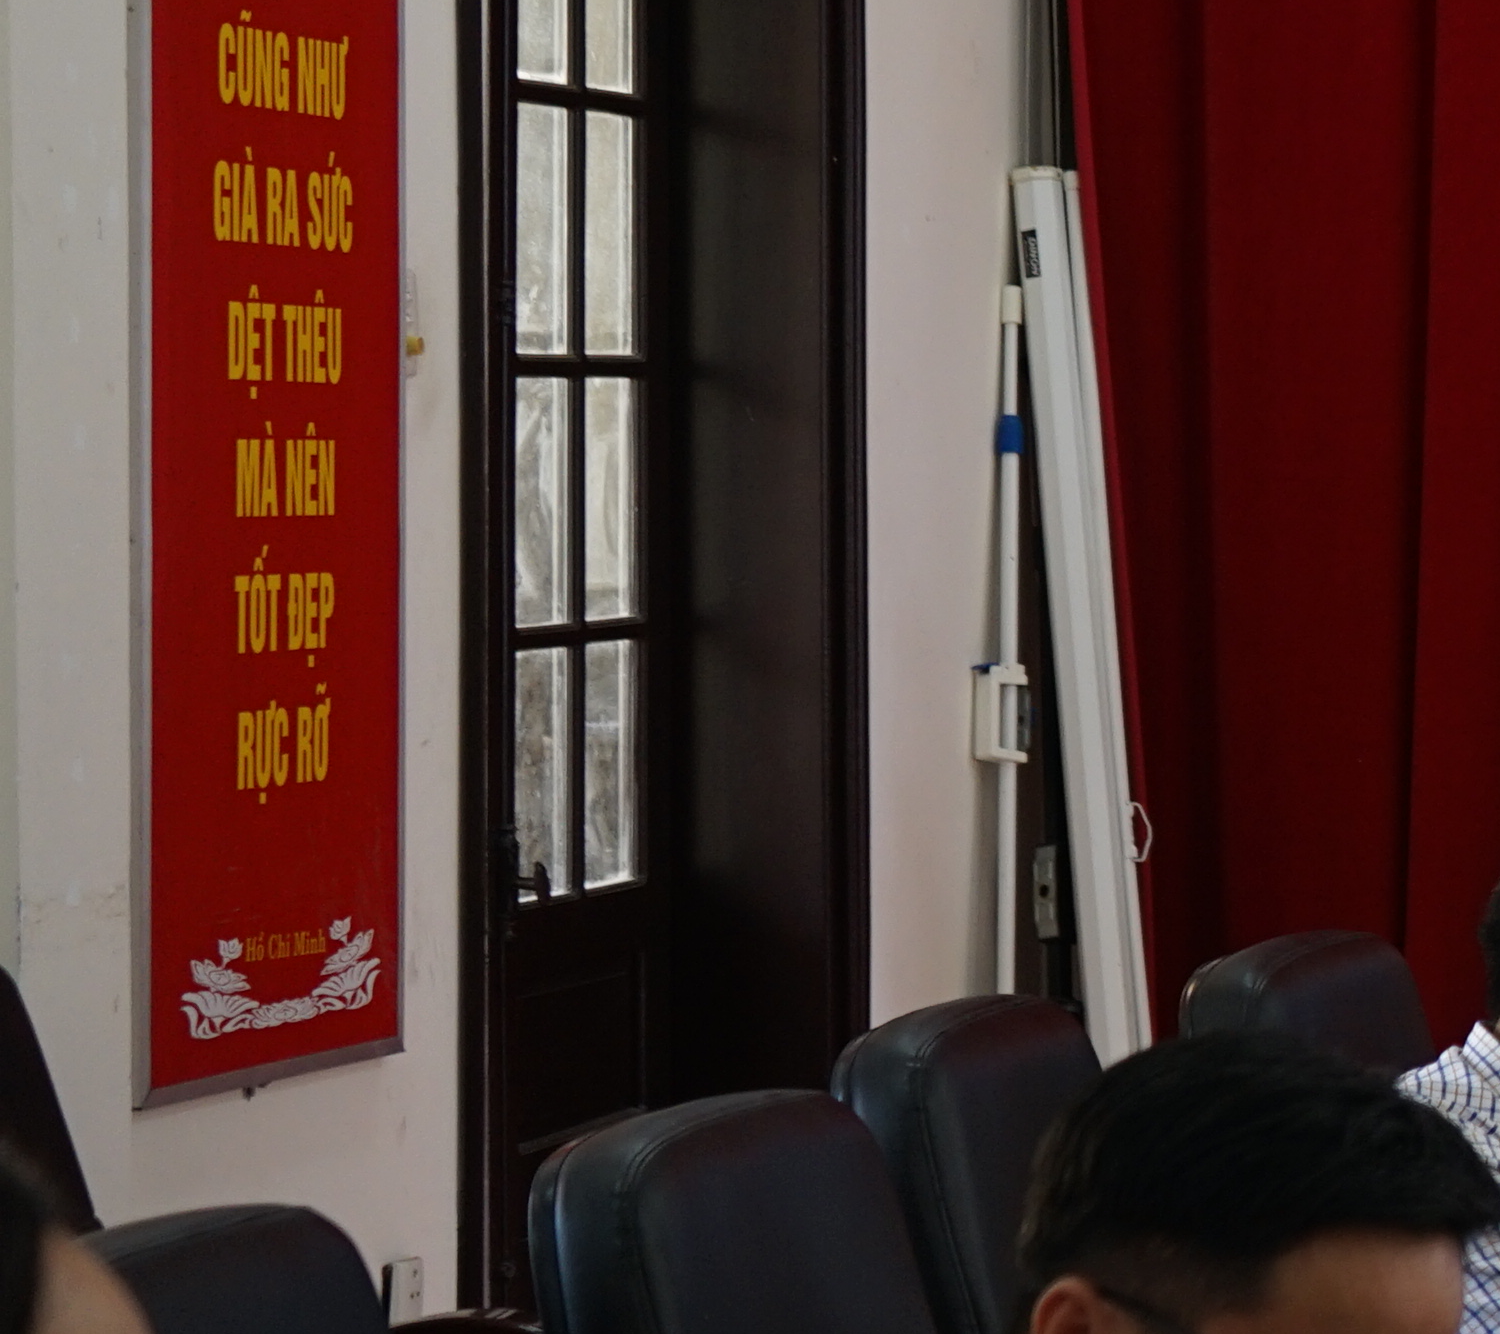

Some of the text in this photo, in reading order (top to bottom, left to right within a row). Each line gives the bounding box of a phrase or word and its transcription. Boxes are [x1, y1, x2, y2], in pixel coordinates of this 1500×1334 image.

[218, 10, 350, 121] CŨNG NHƯ
[213, 146, 354, 254] GIÀ RA SỨC
[228, 285, 342, 400] DỆT THÊU
[236, 421, 336, 518] MÀ NÊN
[235, 545, 336, 668] TỐT ĐẸP
[237, 683, 331, 805] RỰC RỠ
[293, 928, 327, 957] Minh
